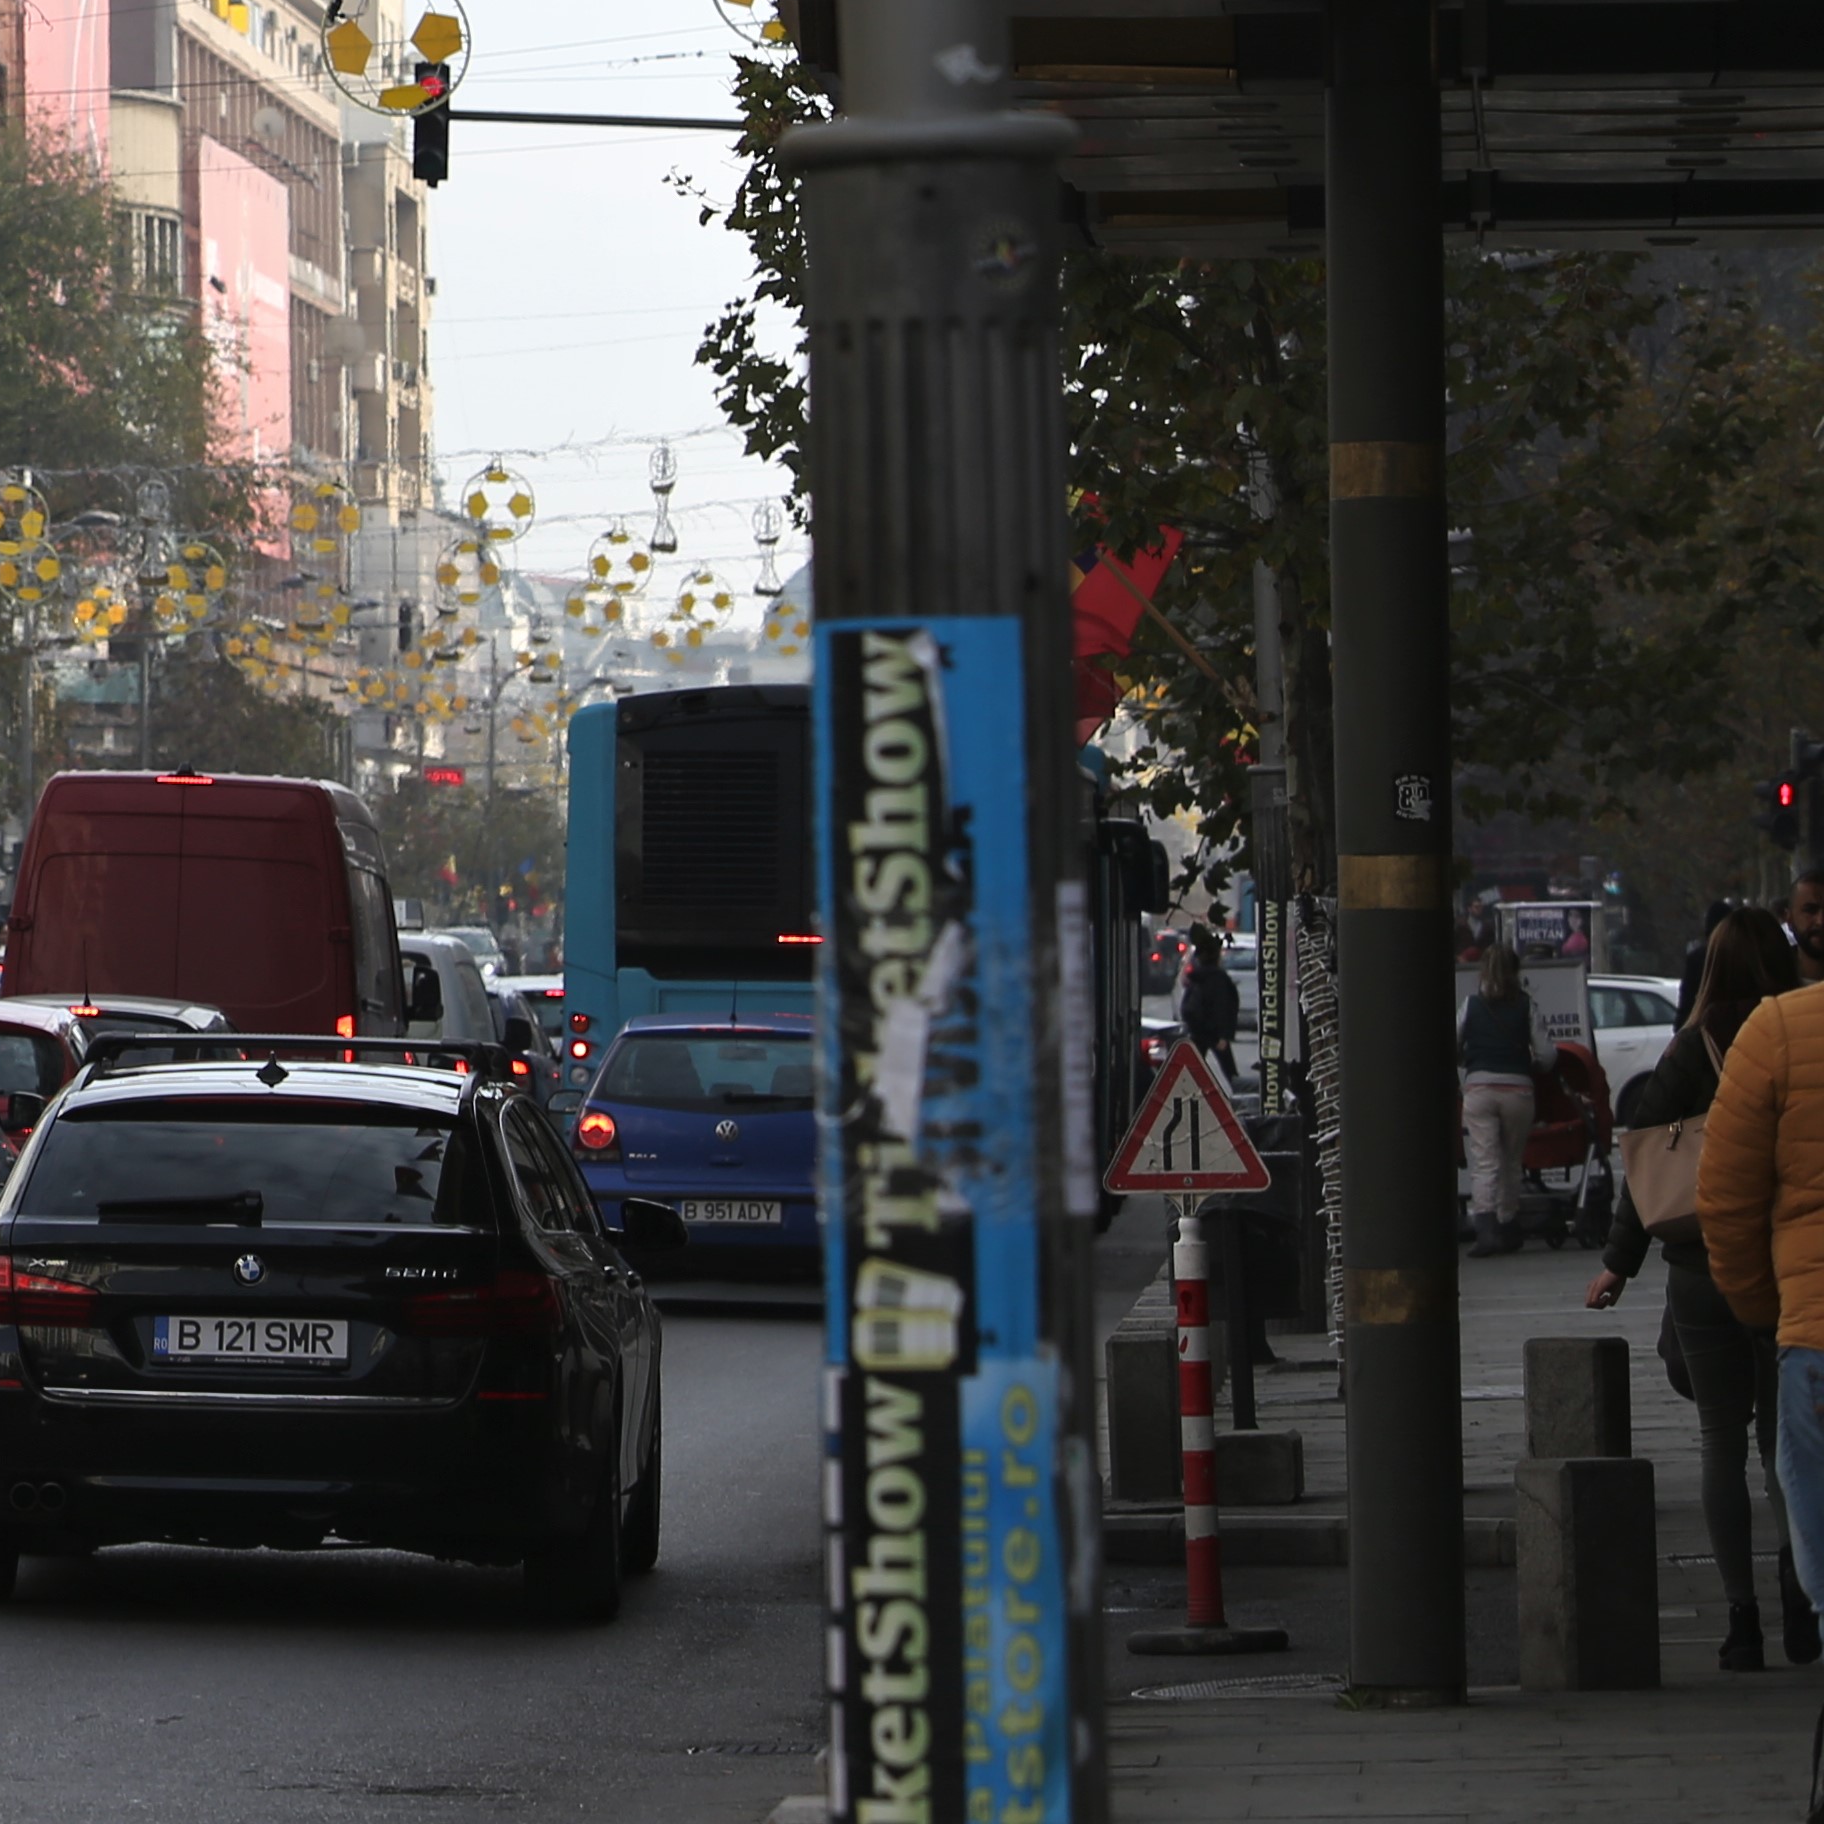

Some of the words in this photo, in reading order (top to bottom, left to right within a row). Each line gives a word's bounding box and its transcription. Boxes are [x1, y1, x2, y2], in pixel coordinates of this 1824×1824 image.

[1261, 899, 1279, 1033] TicketShow
[684, 1203, 697, 1220] B
[704, 1202, 733, 1220] 951
[737, 1203, 775, 1221] ADY
[154, 1337, 168, 1351] RO
[177, 1319, 202, 1352] B
[213, 1320, 257, 1353] 121
[264, 1321, 336, 1355] SMR
[851, 1376, 934, 1824] ketShow
